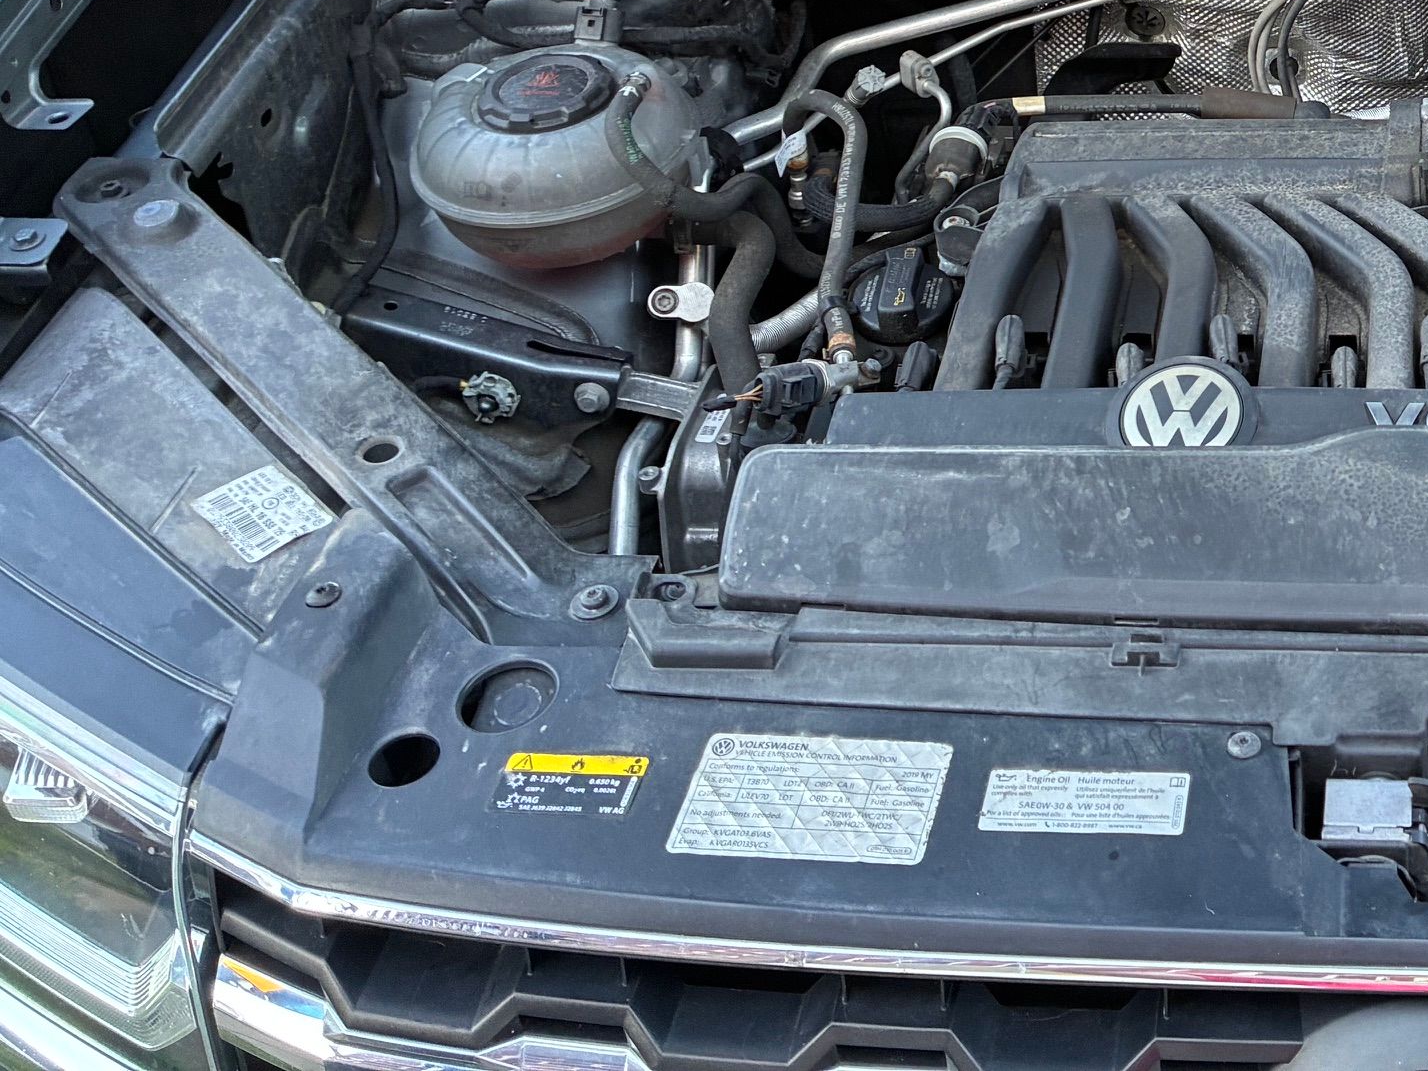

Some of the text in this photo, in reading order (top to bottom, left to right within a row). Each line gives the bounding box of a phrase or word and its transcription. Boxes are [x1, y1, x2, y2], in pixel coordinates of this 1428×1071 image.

[739, 740, 810, 751] VOLKSWAGEN
[735, 749, 898, 763] VEHICLE EMISSION CONTROL INFORMATION
[920, 771, 934, 779] MY
[1026, 773, 1056, 784] Engine
[1078, 776, 1101, 784] Huile
[529, 775, 570, 785] R-1234yf
[896, 784, 931, 793] Gasoline
[521, 795, 539, 803] PAG
[891, 799, 926, 808] Gasoline
[612, 806, 624, 814] AG
